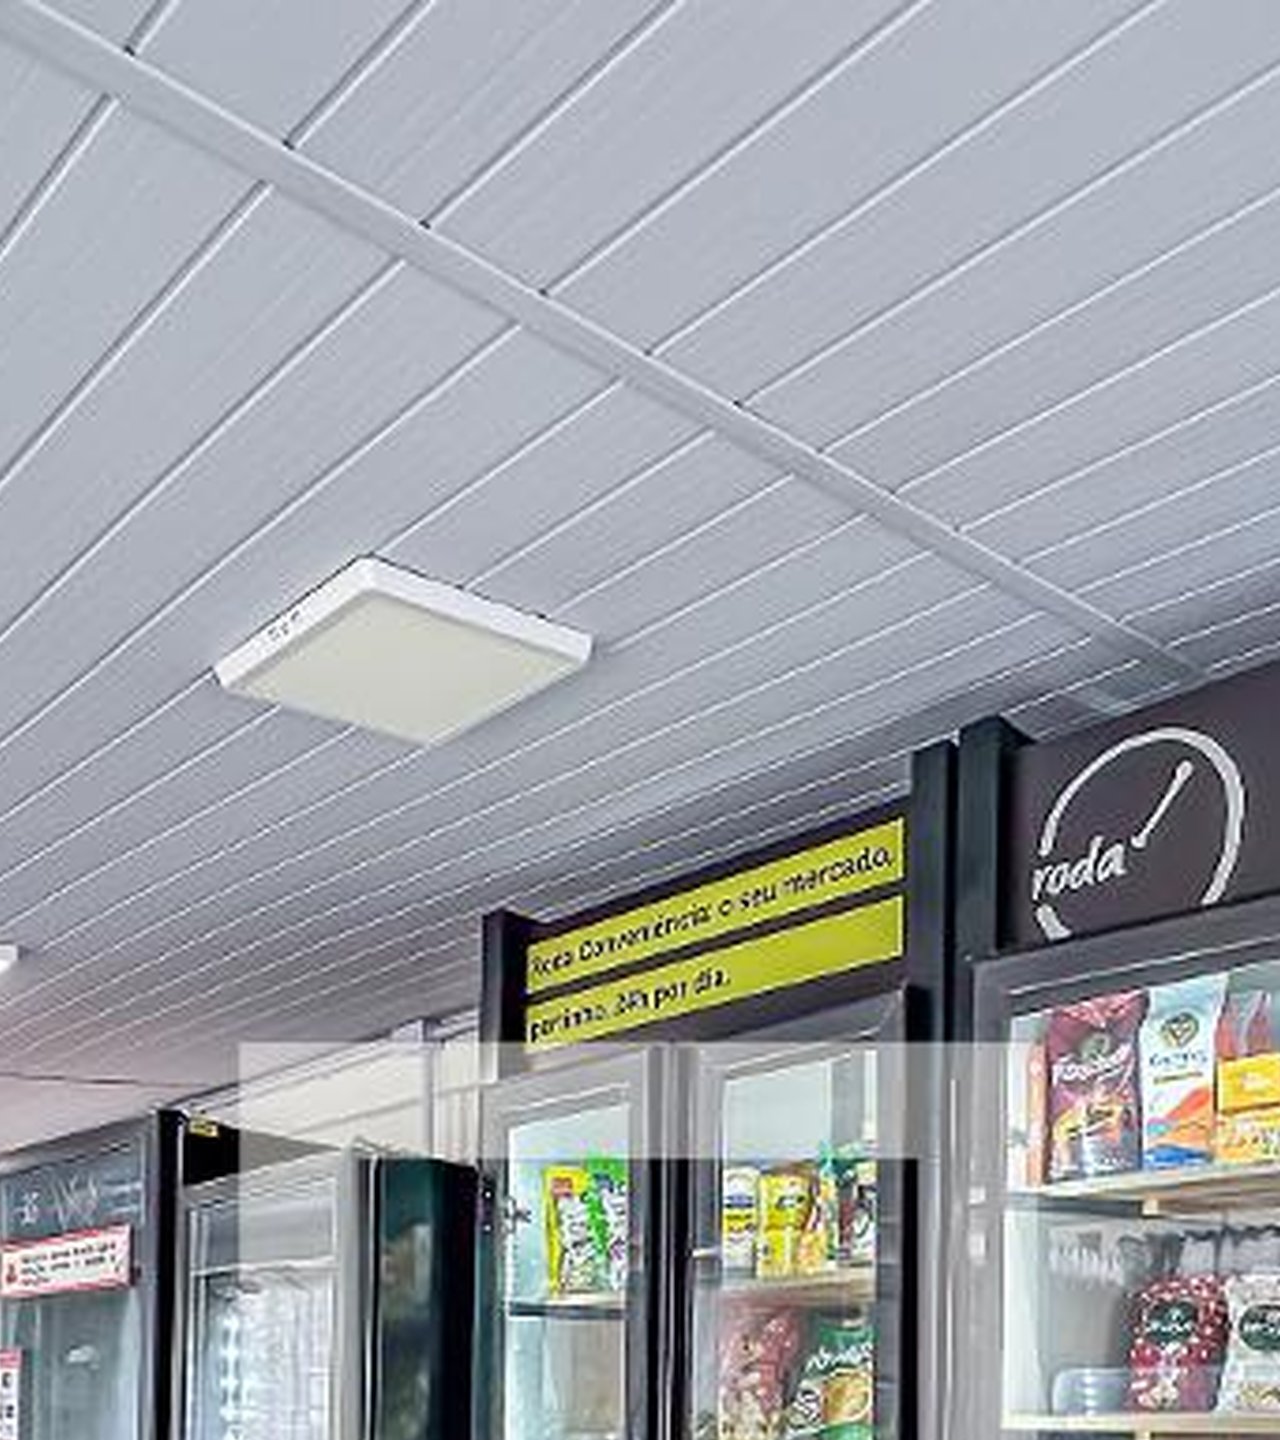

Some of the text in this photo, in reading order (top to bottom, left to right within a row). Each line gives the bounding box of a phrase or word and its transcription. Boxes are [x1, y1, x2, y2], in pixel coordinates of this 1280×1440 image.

[1031, 836, 1128, 899] roda
[740, 887, 777, 910] seu
[653, 979, 688, 1010] por
